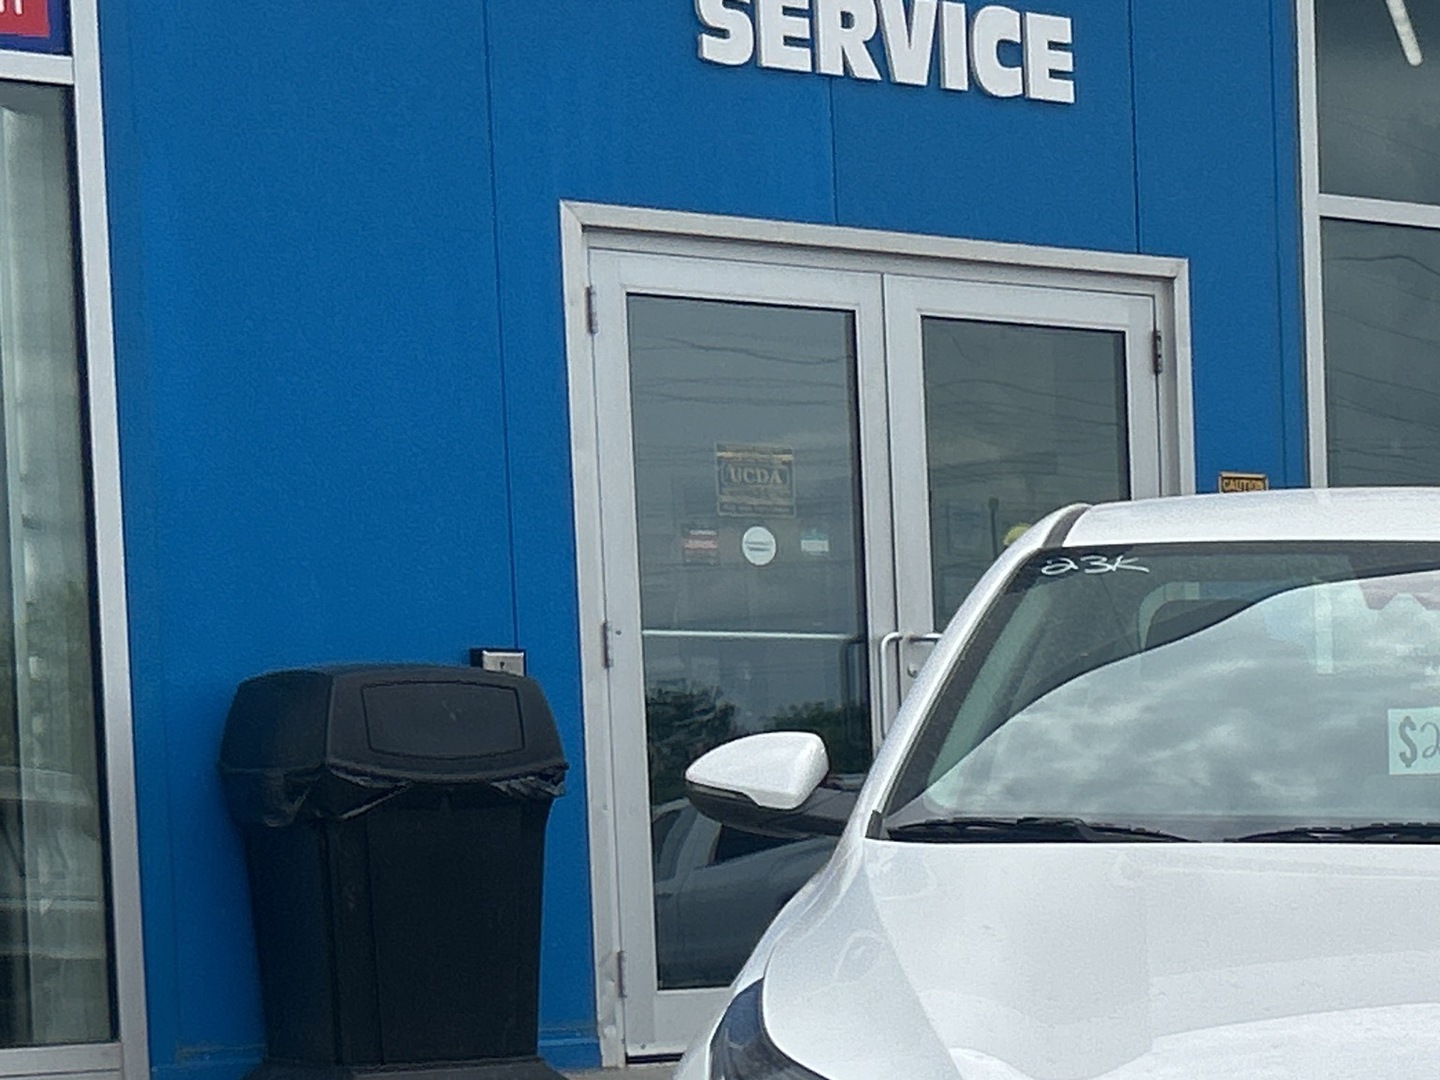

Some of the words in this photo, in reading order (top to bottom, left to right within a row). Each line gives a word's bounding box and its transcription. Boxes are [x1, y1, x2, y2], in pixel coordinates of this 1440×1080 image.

[694, 0, 1075, 104] SERVICE
[728, 465, 784, 485] UCDA
[1041, 555, 1150, 575] 23K
